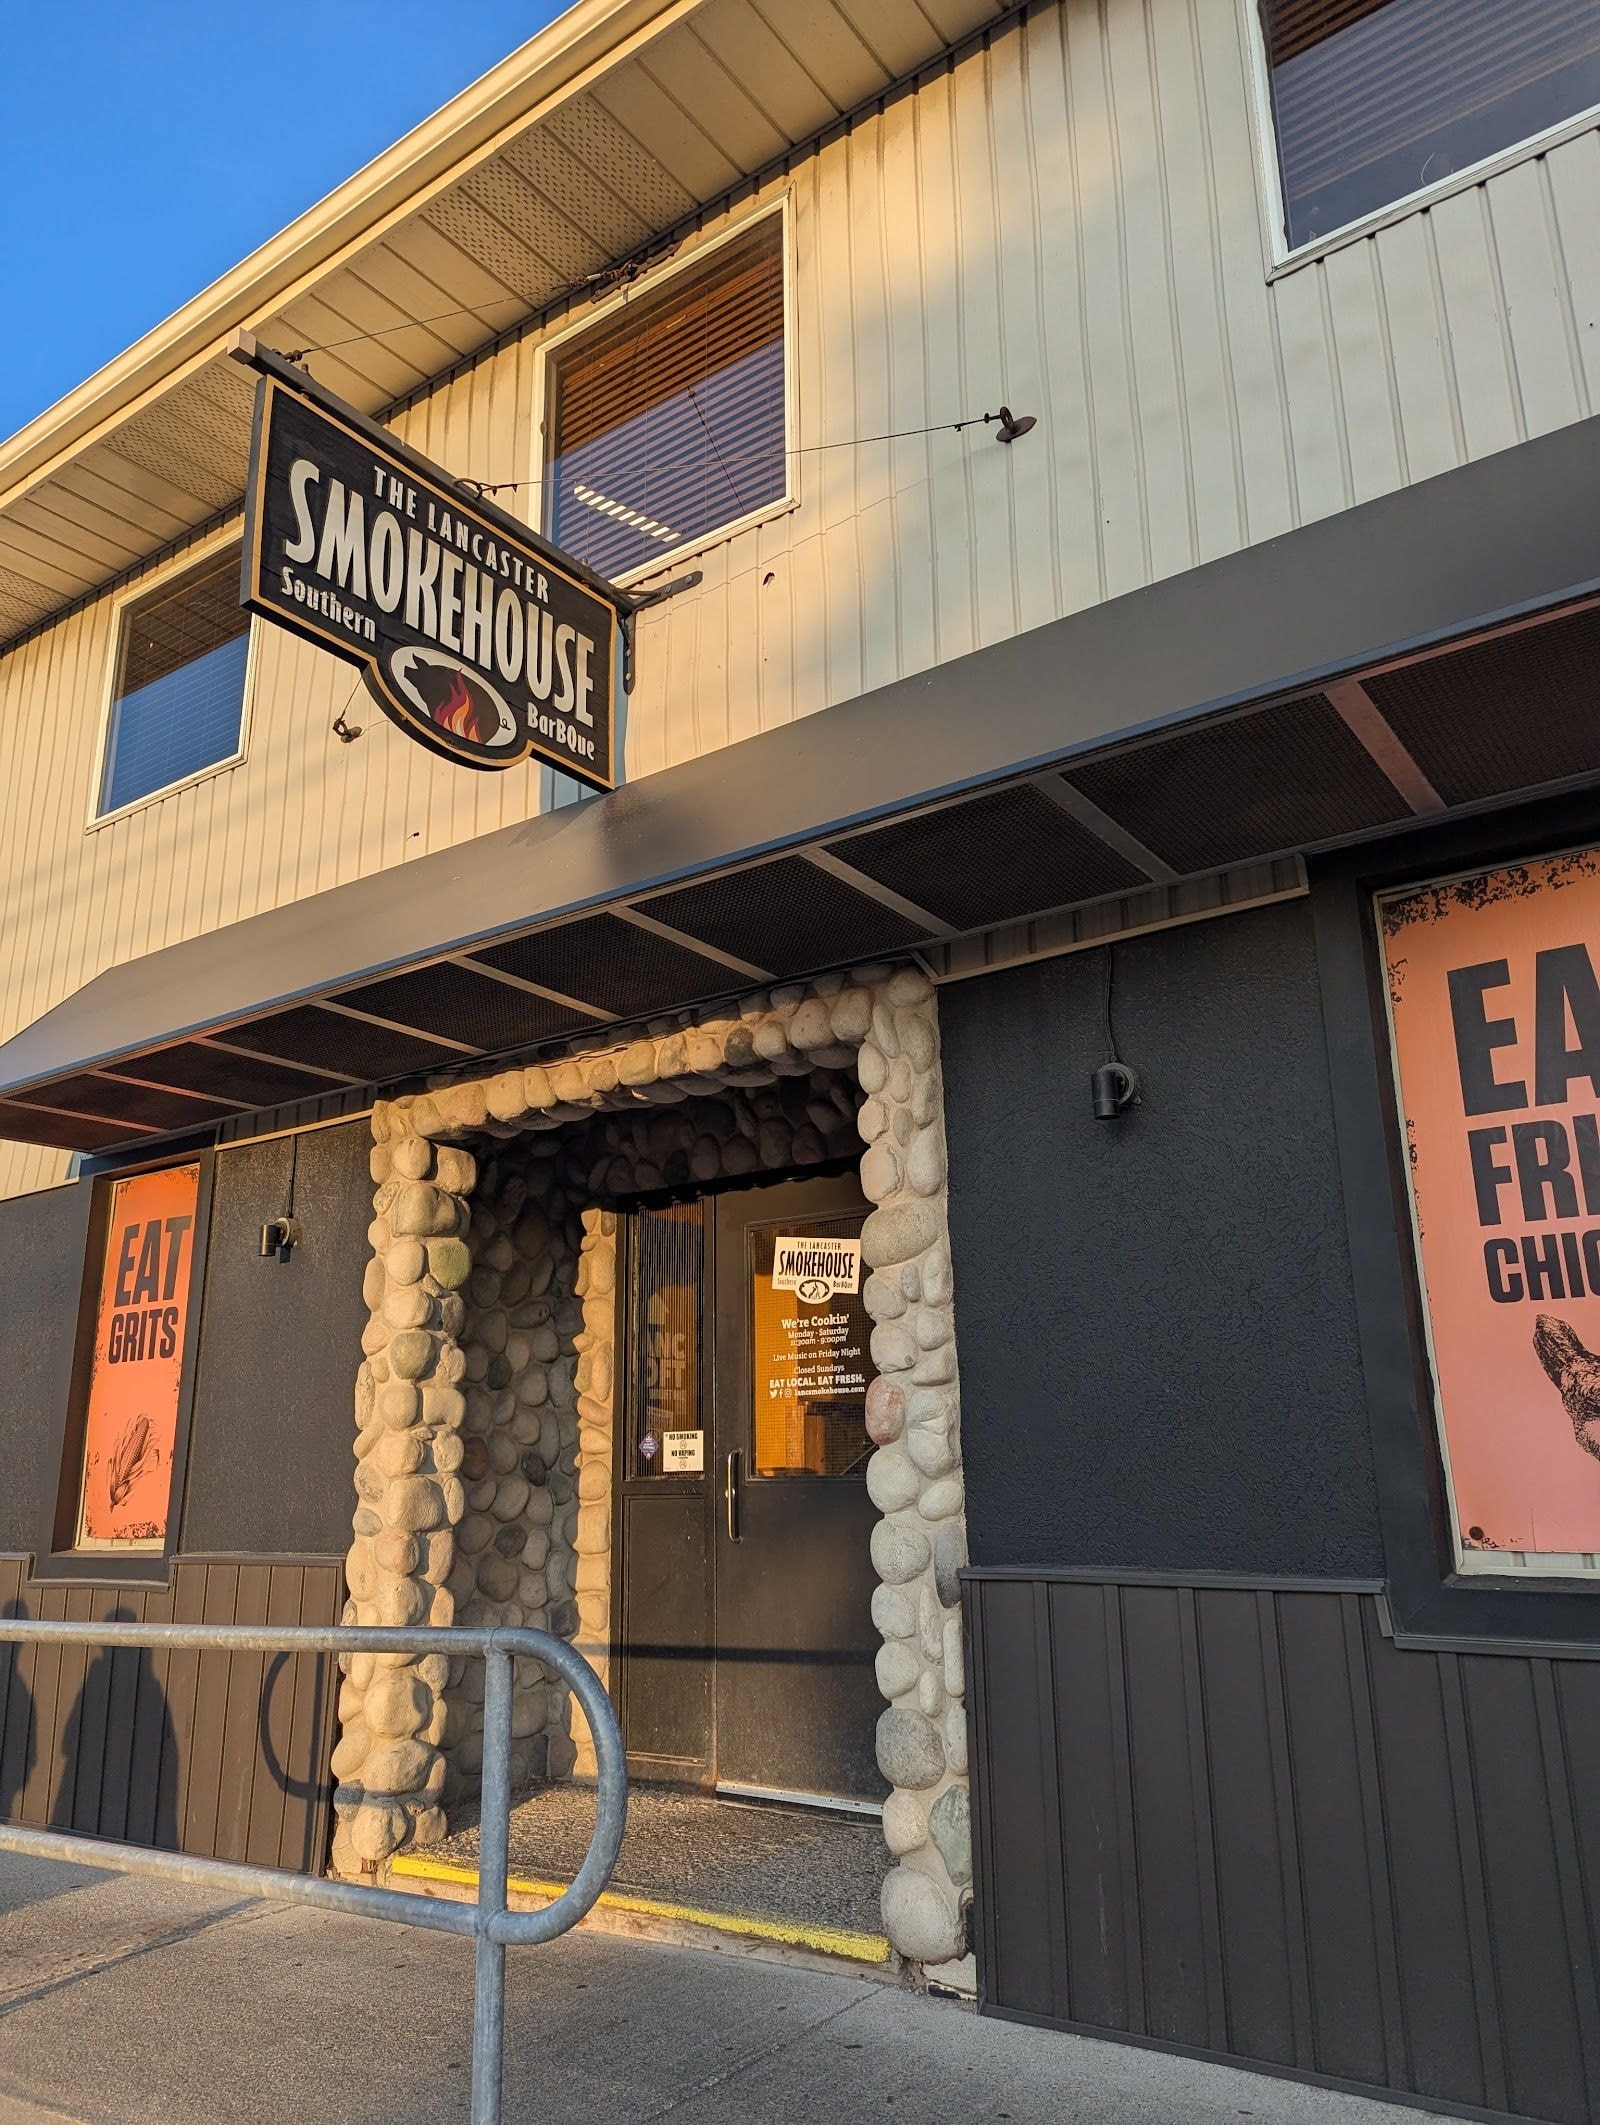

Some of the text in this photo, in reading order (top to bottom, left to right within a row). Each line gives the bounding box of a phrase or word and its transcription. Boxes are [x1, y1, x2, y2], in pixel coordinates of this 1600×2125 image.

[374, 465, 549, 604] THE LANCASTER
[284, 459, 595, 728] SMOKEHOUSE
[281, 566, 376, 642] Southern
[527, 701, 595, 762] BarBQue
[797, 1241, 842, 1251] THE LANCASTER
[114, 1215, 192, 1308] EAT
[778, 1250, 855, 1279] SMOKEHOUSE
[781, 1312, 850, 1330] We're Cookin'
[108, 1306, 178, 1365] GRITS
[788, 1329, 815, 1339] Monday
[818, 1326, 849, 1336] Saturday
[820, 1335, 847, 1344] 9:00pm
[773, 1353, 787, 1362] Live
[787, 1351, 808, 1360] Music
[818, 1348, 840, 1359] Friday
[840, 1347, 861, 1358] Night
[793, 1363, 845, 1375] Closed Sundays
[769, 1373, 866, 1388] EAT LOCAL. EAT FRESH.
[794, 1386, 866, 1397] lancsmokehouse.com
